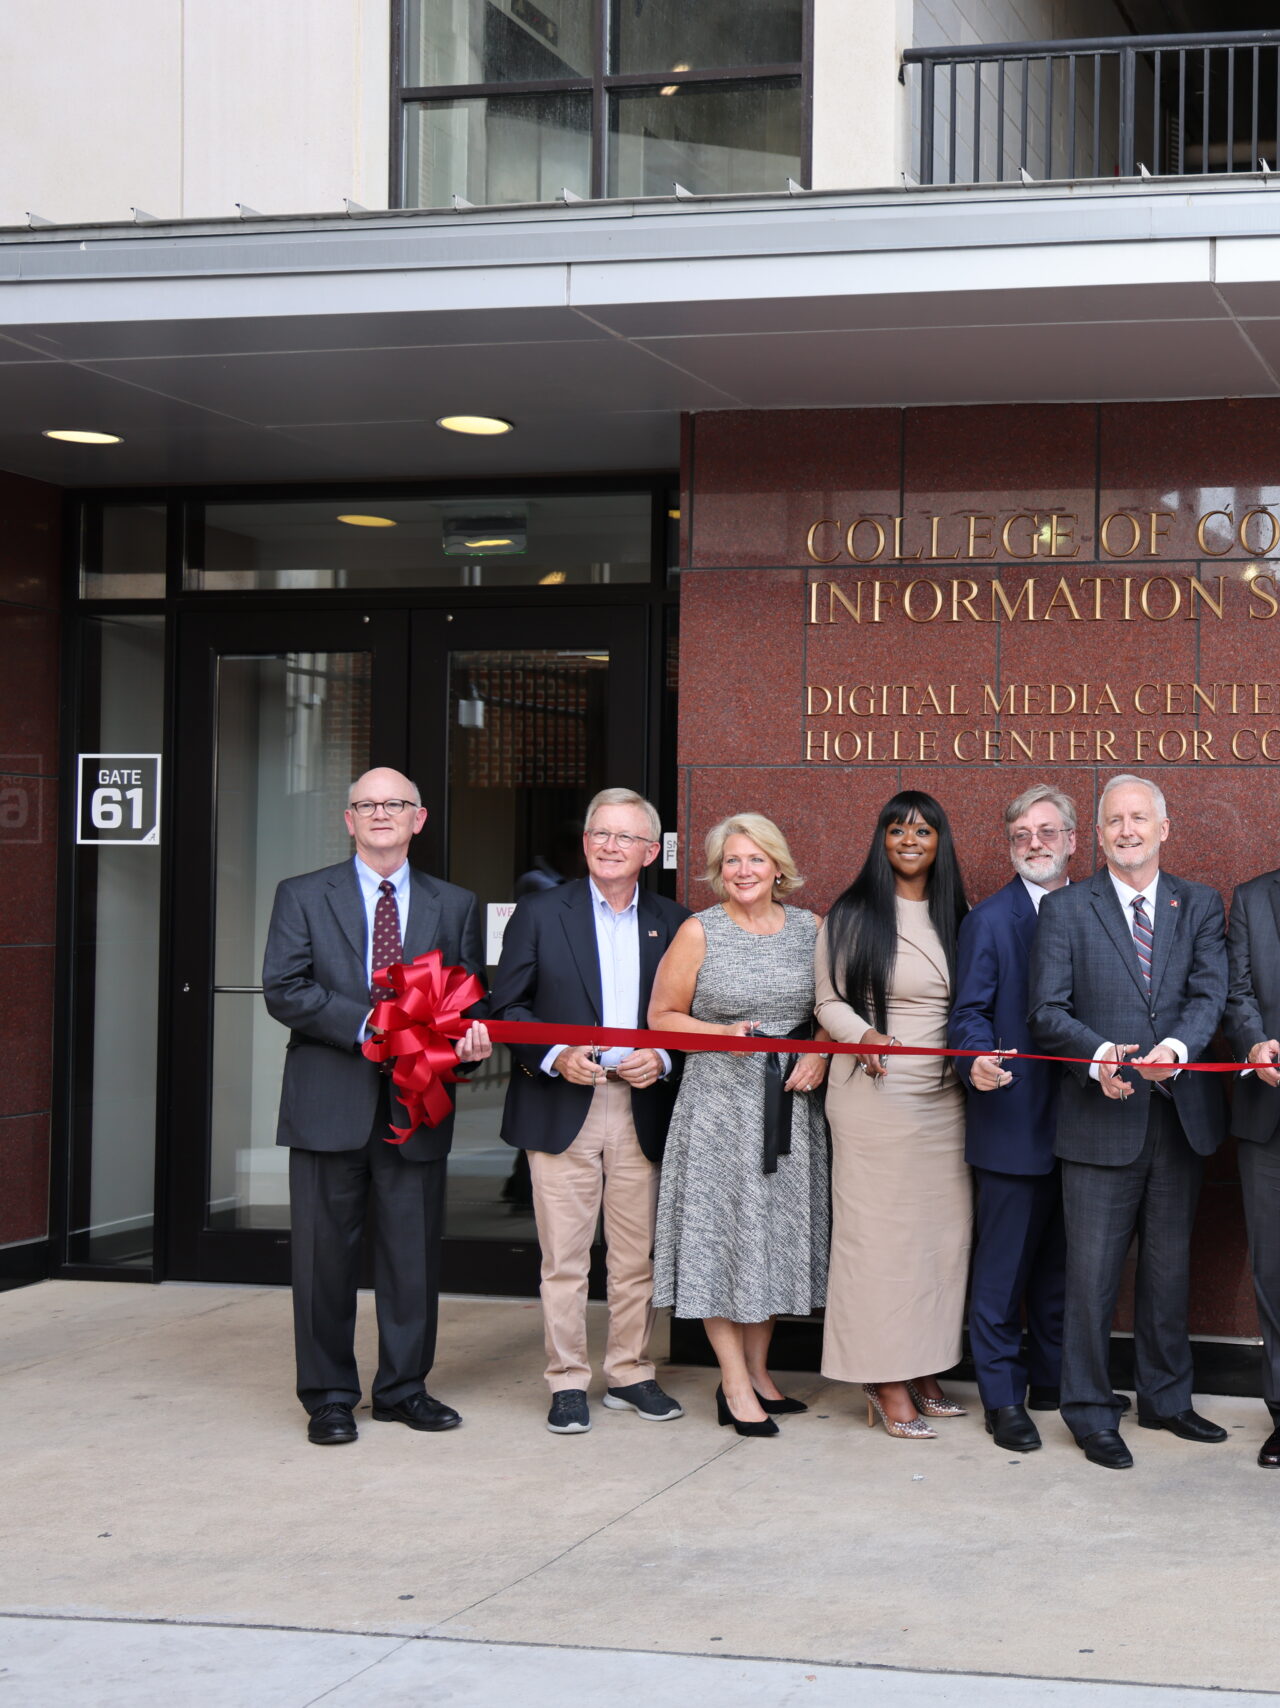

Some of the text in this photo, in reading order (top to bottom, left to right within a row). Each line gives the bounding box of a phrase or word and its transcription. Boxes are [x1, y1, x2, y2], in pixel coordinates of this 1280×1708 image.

[807, 511, 1082, 563] COLLEGE
[1100, 510, 1177, 557] OF
[805, 575, 1226, 626] INFORMATION
[803, 684, 970, 718] DIGITAL
[982, 683, 1122, 717] MEDIA
[803, 729, 939, 762] HOLLE
[953, 728, 1120, 762] CENTER
[1131, 728, 1218, 762] FOR
[98, 769, 142, 785] GATE
[91, 787, 143, 829] 61
